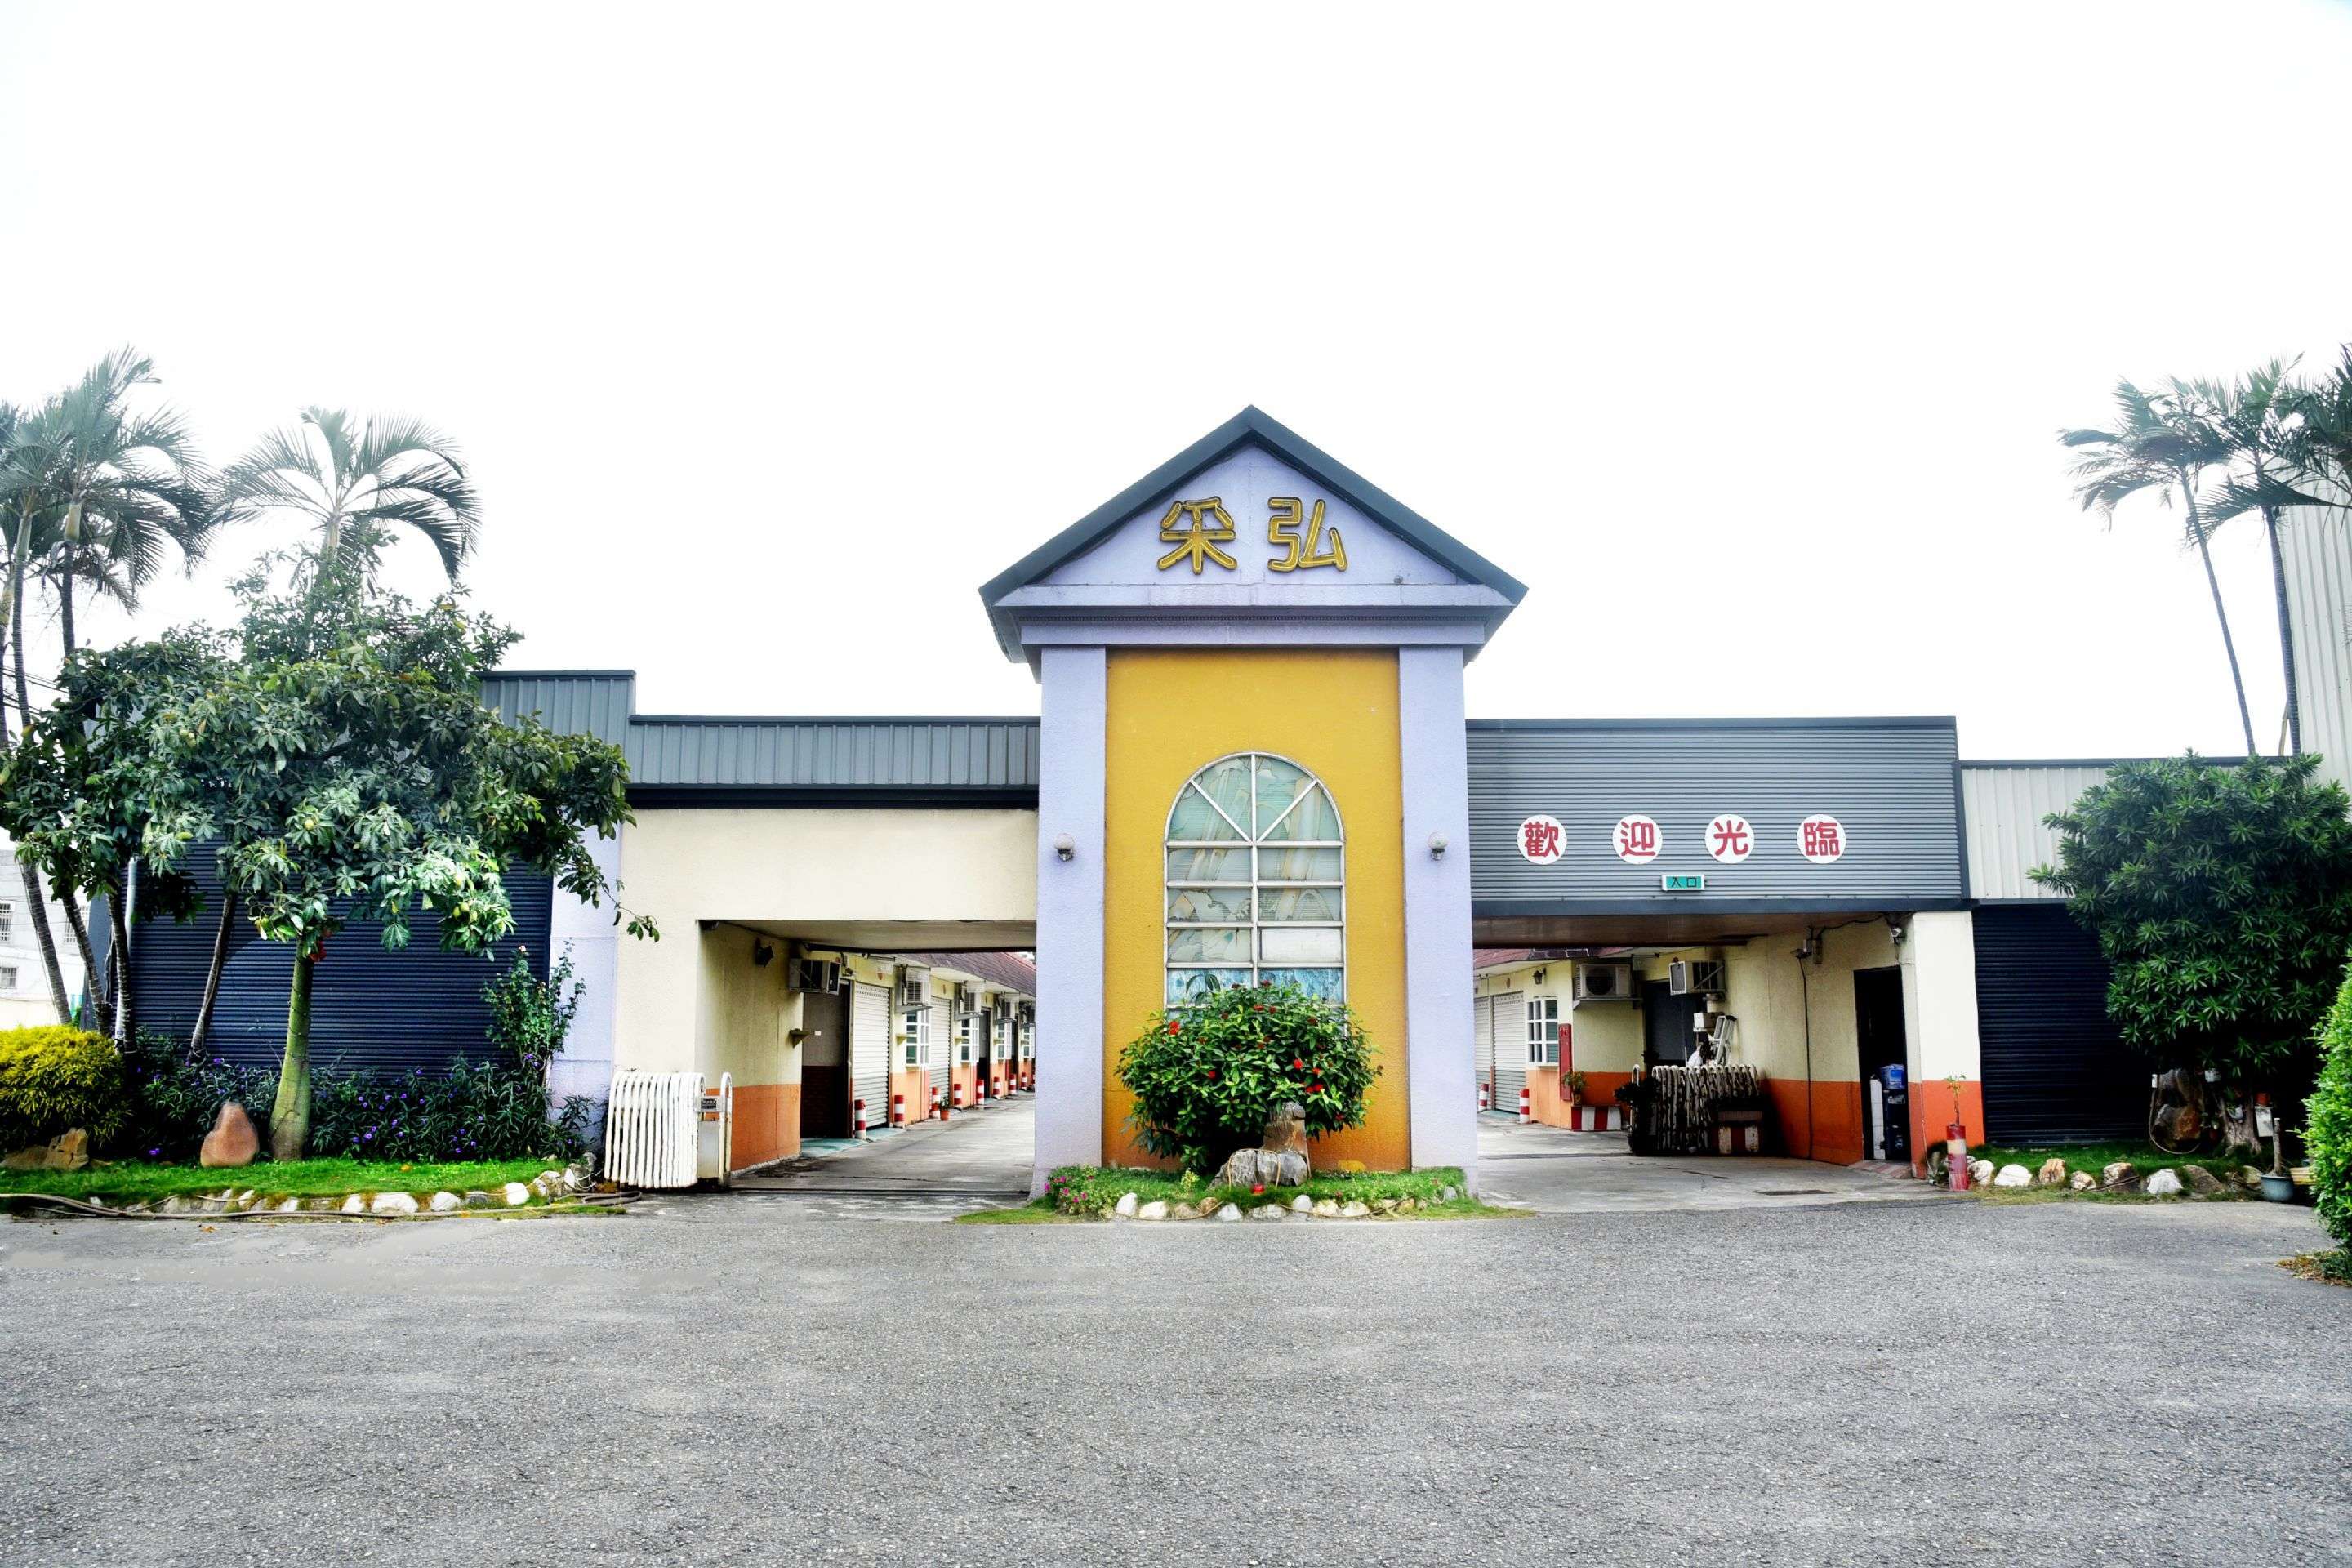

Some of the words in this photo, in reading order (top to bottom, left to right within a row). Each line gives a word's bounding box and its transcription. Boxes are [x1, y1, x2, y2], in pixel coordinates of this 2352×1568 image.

[1524, 821, 1841, 857] 歡迎光臨
[1671, 877, 1697, 888] 入口
